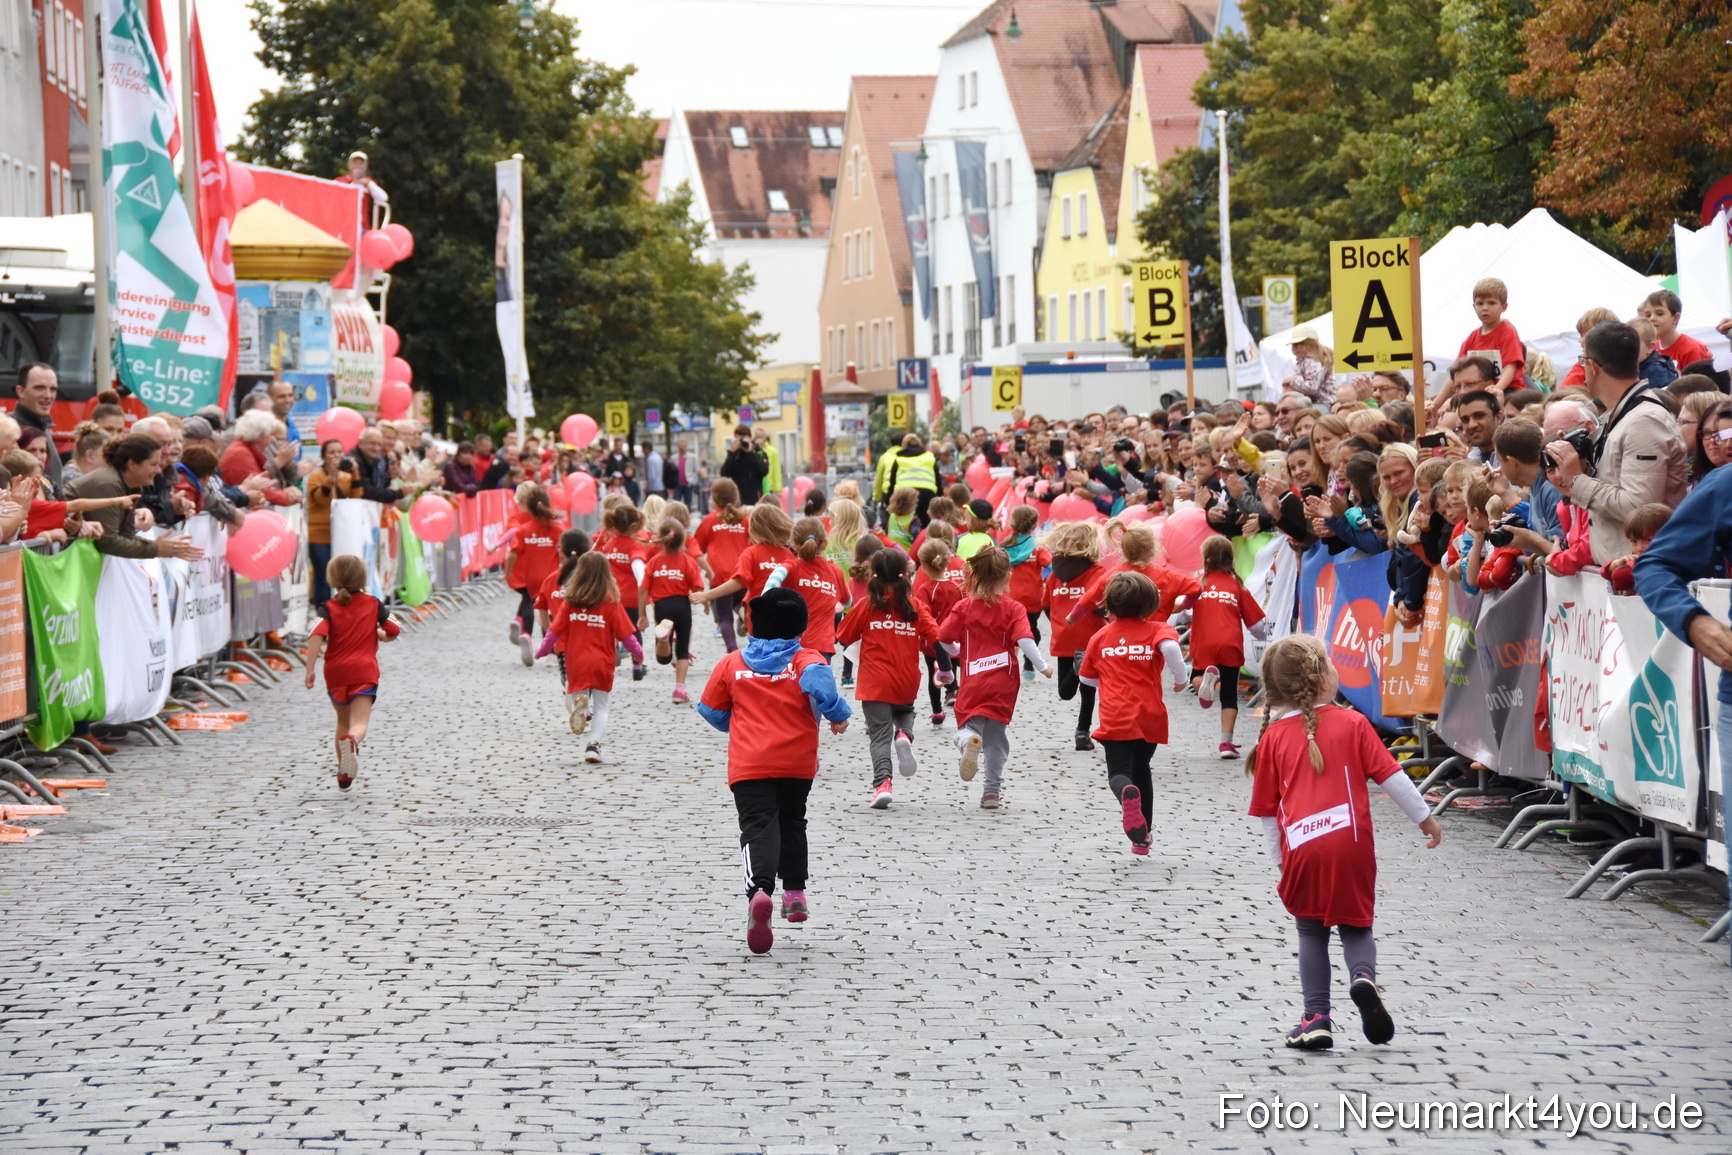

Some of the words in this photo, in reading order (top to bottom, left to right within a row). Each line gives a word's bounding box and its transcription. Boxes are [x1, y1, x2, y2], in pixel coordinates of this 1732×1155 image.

[1341, 244, 1410, 269] Block
[1139, 265, 1182, 281] Block
[1149, 288, 1176, 327] B
[1352, 279, 1403, 343] A
[333, 309, 374, 354] AVIA
[140, 380, 195, 408] 6352
[999, 380, 1014, 402] C
[611, 412, 623, 428] D
[893, 404, 904, 420] D
[799, 574, 837, 592] RÖDL
[869, 613, 916, 631] RÖDL
[1101, 637, 1154, 658] RÖDL
[1303, 816, 1332, 835] DEHN
